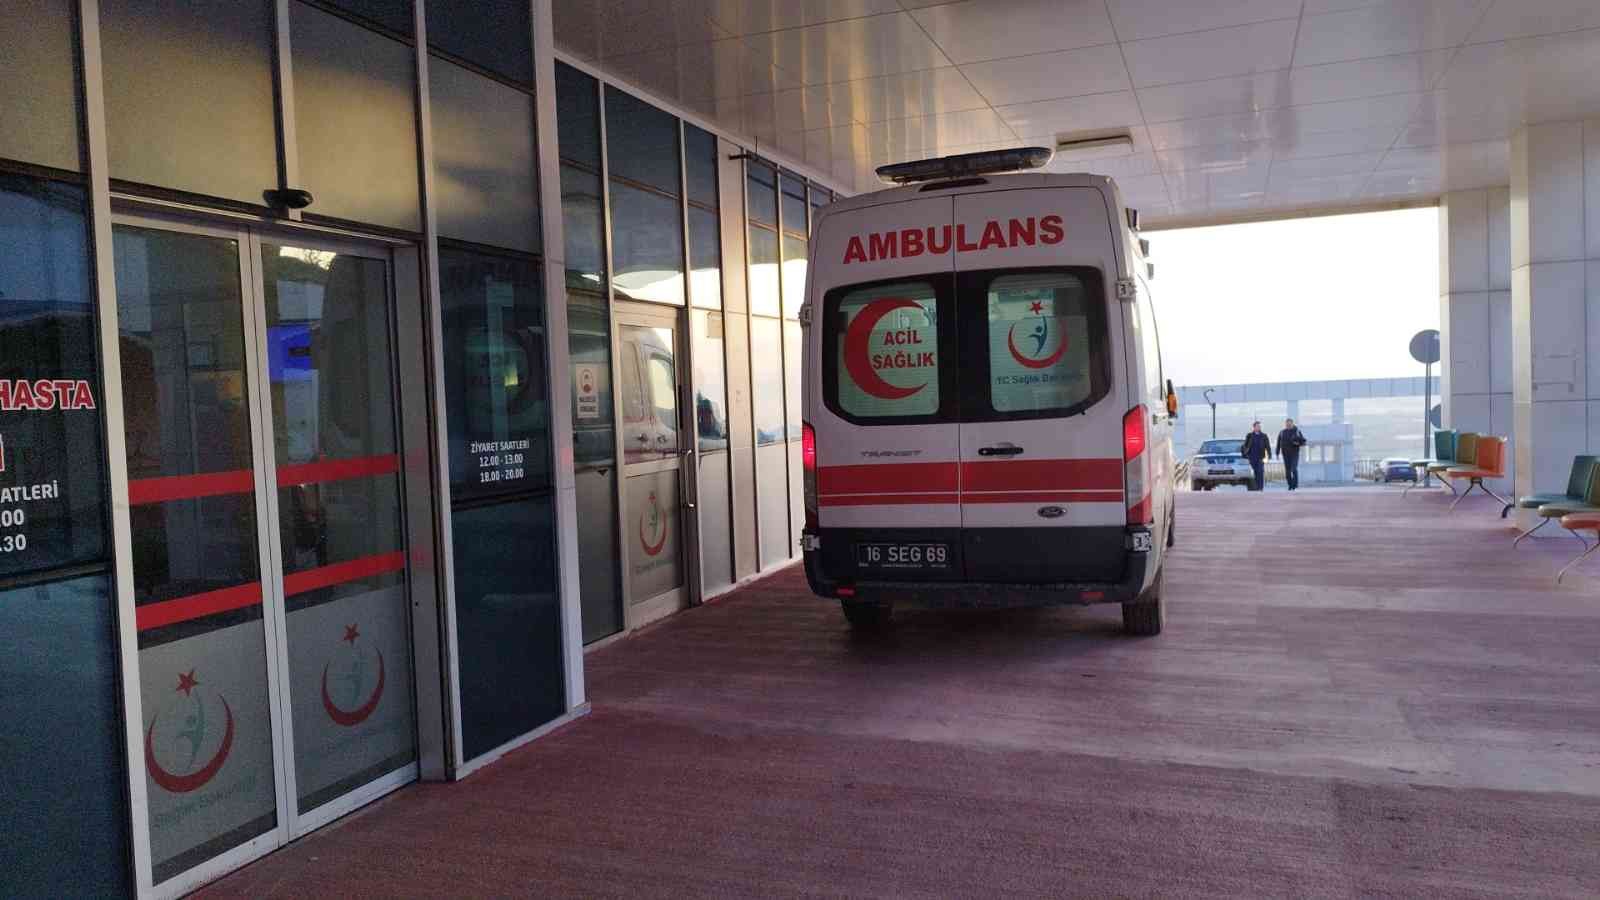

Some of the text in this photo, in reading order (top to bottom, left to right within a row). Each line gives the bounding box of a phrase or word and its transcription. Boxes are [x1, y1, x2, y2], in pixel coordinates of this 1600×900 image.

[843, 215, 1064, 265] AMBULANS
[884, 327, 922, 345] ACİL
[872, 350, 935, 369] SAĞLIK
[471, 438, 529, 453] ZİYARET SAATLERİ
[480, 455, 499, 467] 12.00
[505, 453, 523, 465] 13.00
[480, 470, 500, 483] 18.00
[505, 468, 524, 480] 20.00
[867, 546, 945, 562] 16 SEG 69
